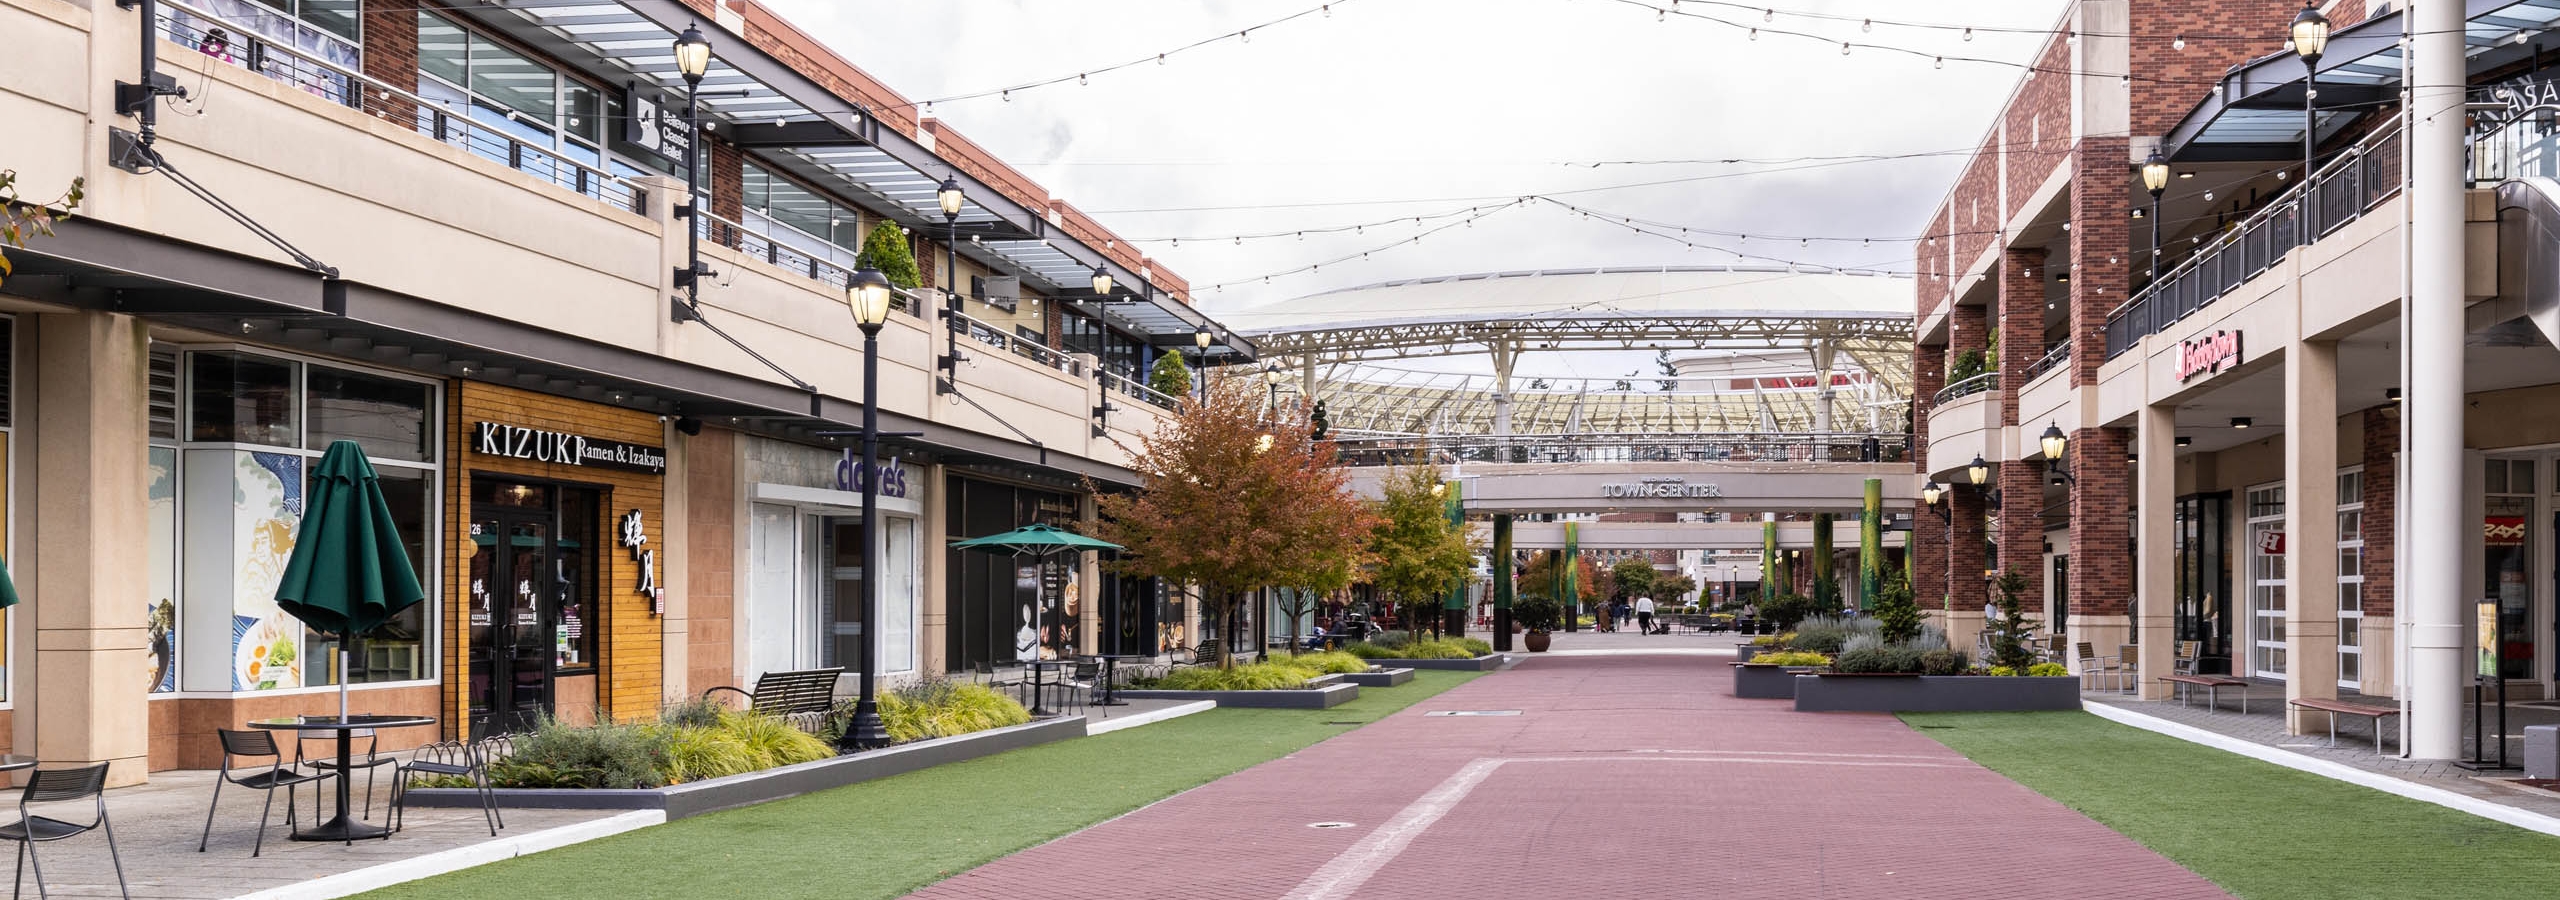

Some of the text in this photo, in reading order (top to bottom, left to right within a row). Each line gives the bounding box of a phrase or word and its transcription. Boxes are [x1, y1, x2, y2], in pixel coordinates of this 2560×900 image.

[663, 110, 690, 133] Bellevu
[663, 126, 690, 150] Classica
[663, 141, 683, 162] Ballet
[481, 421, 665, 472] KIZUKI Ramen & Izakaya
[835, 446, 906, 498] clare's
[1602, 483, 1721, 497] TOWN CENTER
